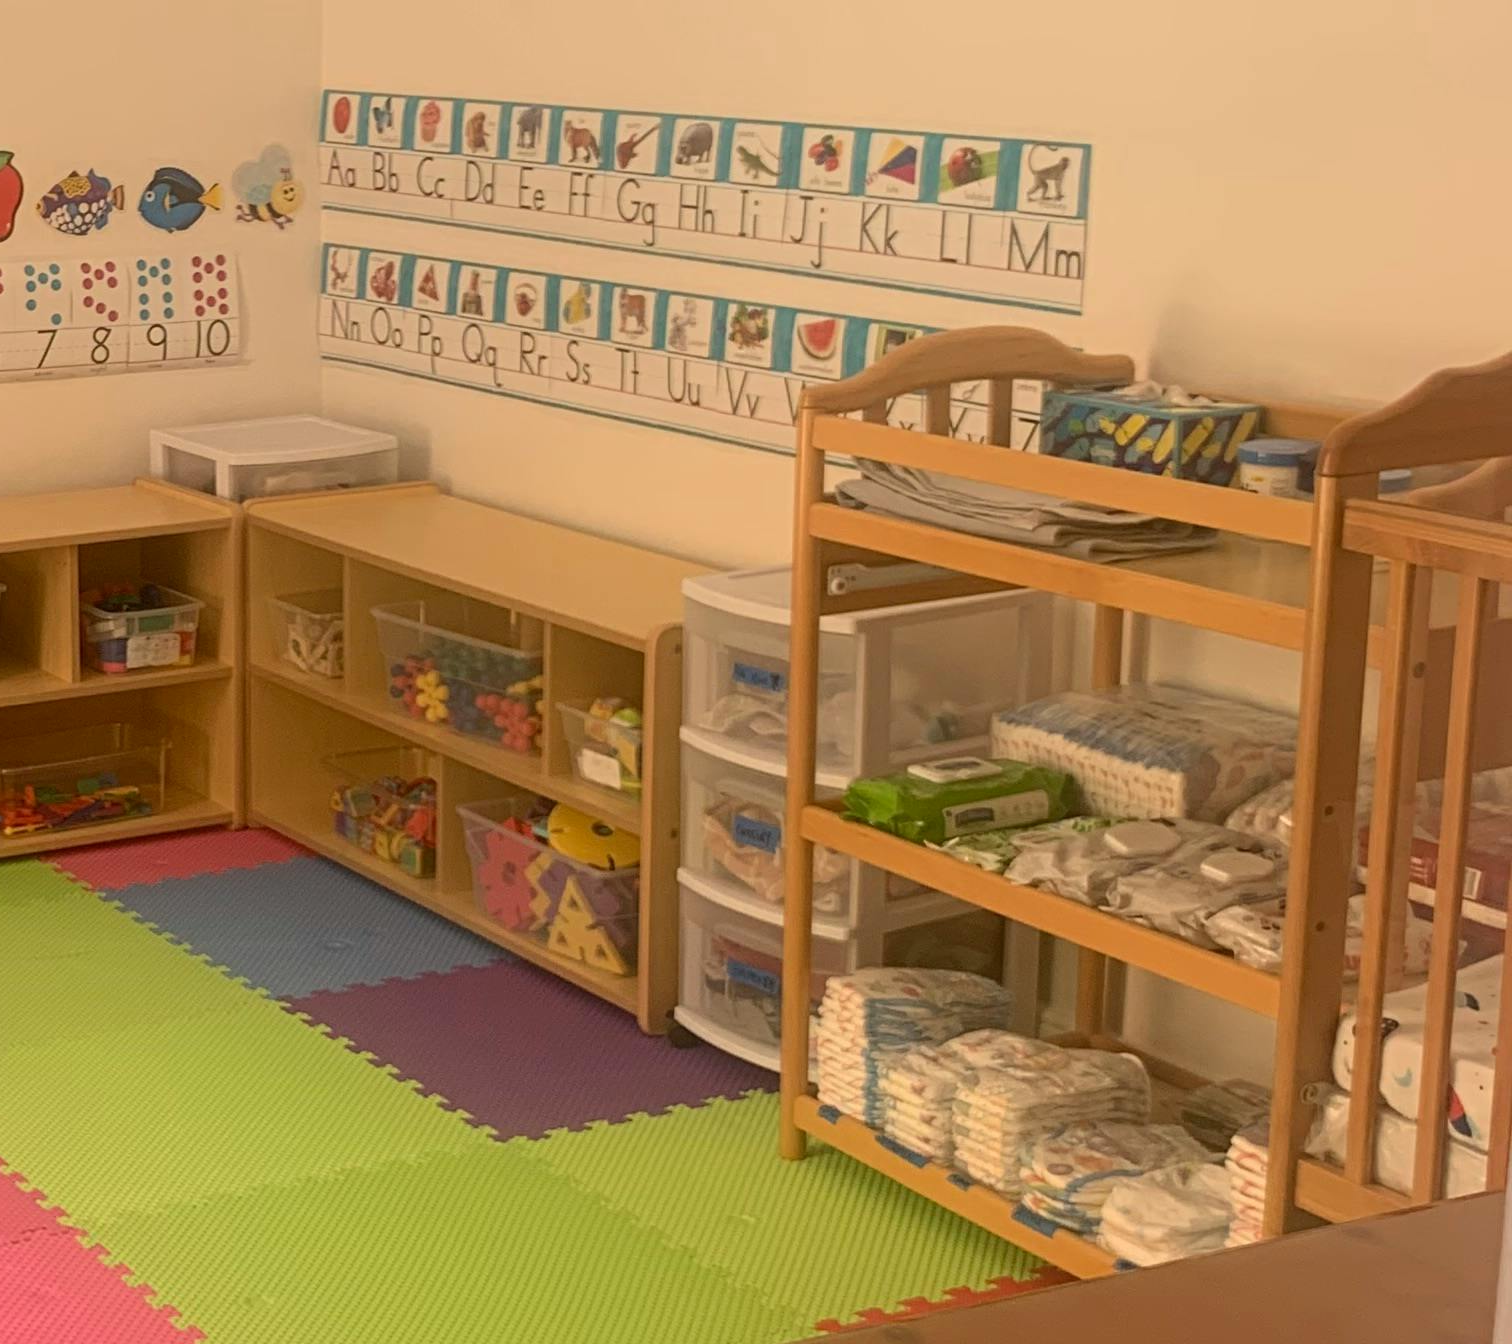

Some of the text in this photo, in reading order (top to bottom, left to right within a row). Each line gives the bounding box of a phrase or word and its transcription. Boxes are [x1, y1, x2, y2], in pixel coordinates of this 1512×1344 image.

[327, 150, 1081, 279] Aa Bb Cc Dd Ee Ff Gg Hh Ii Jj Kk Ll Mm
[37, 329, 58, 369] 7
[91, 326, 112, 364] 8
[147, 324, 168, 361] 9
[195, 319, 230, 358] 10
[332, 300, 361, 341] Nn
[370, 307, 403, 348] Oo
[418, 314, 444, 375] Pp
[461, 323, 503, 388] Qq
[520, 331, 548, 376] Rr
[566, 340, 592, 385] Ss
[615, 347, 639, 395] Tt
[667, 356, 700, 406] Uu
[725, 367, 760, 418] Vv
